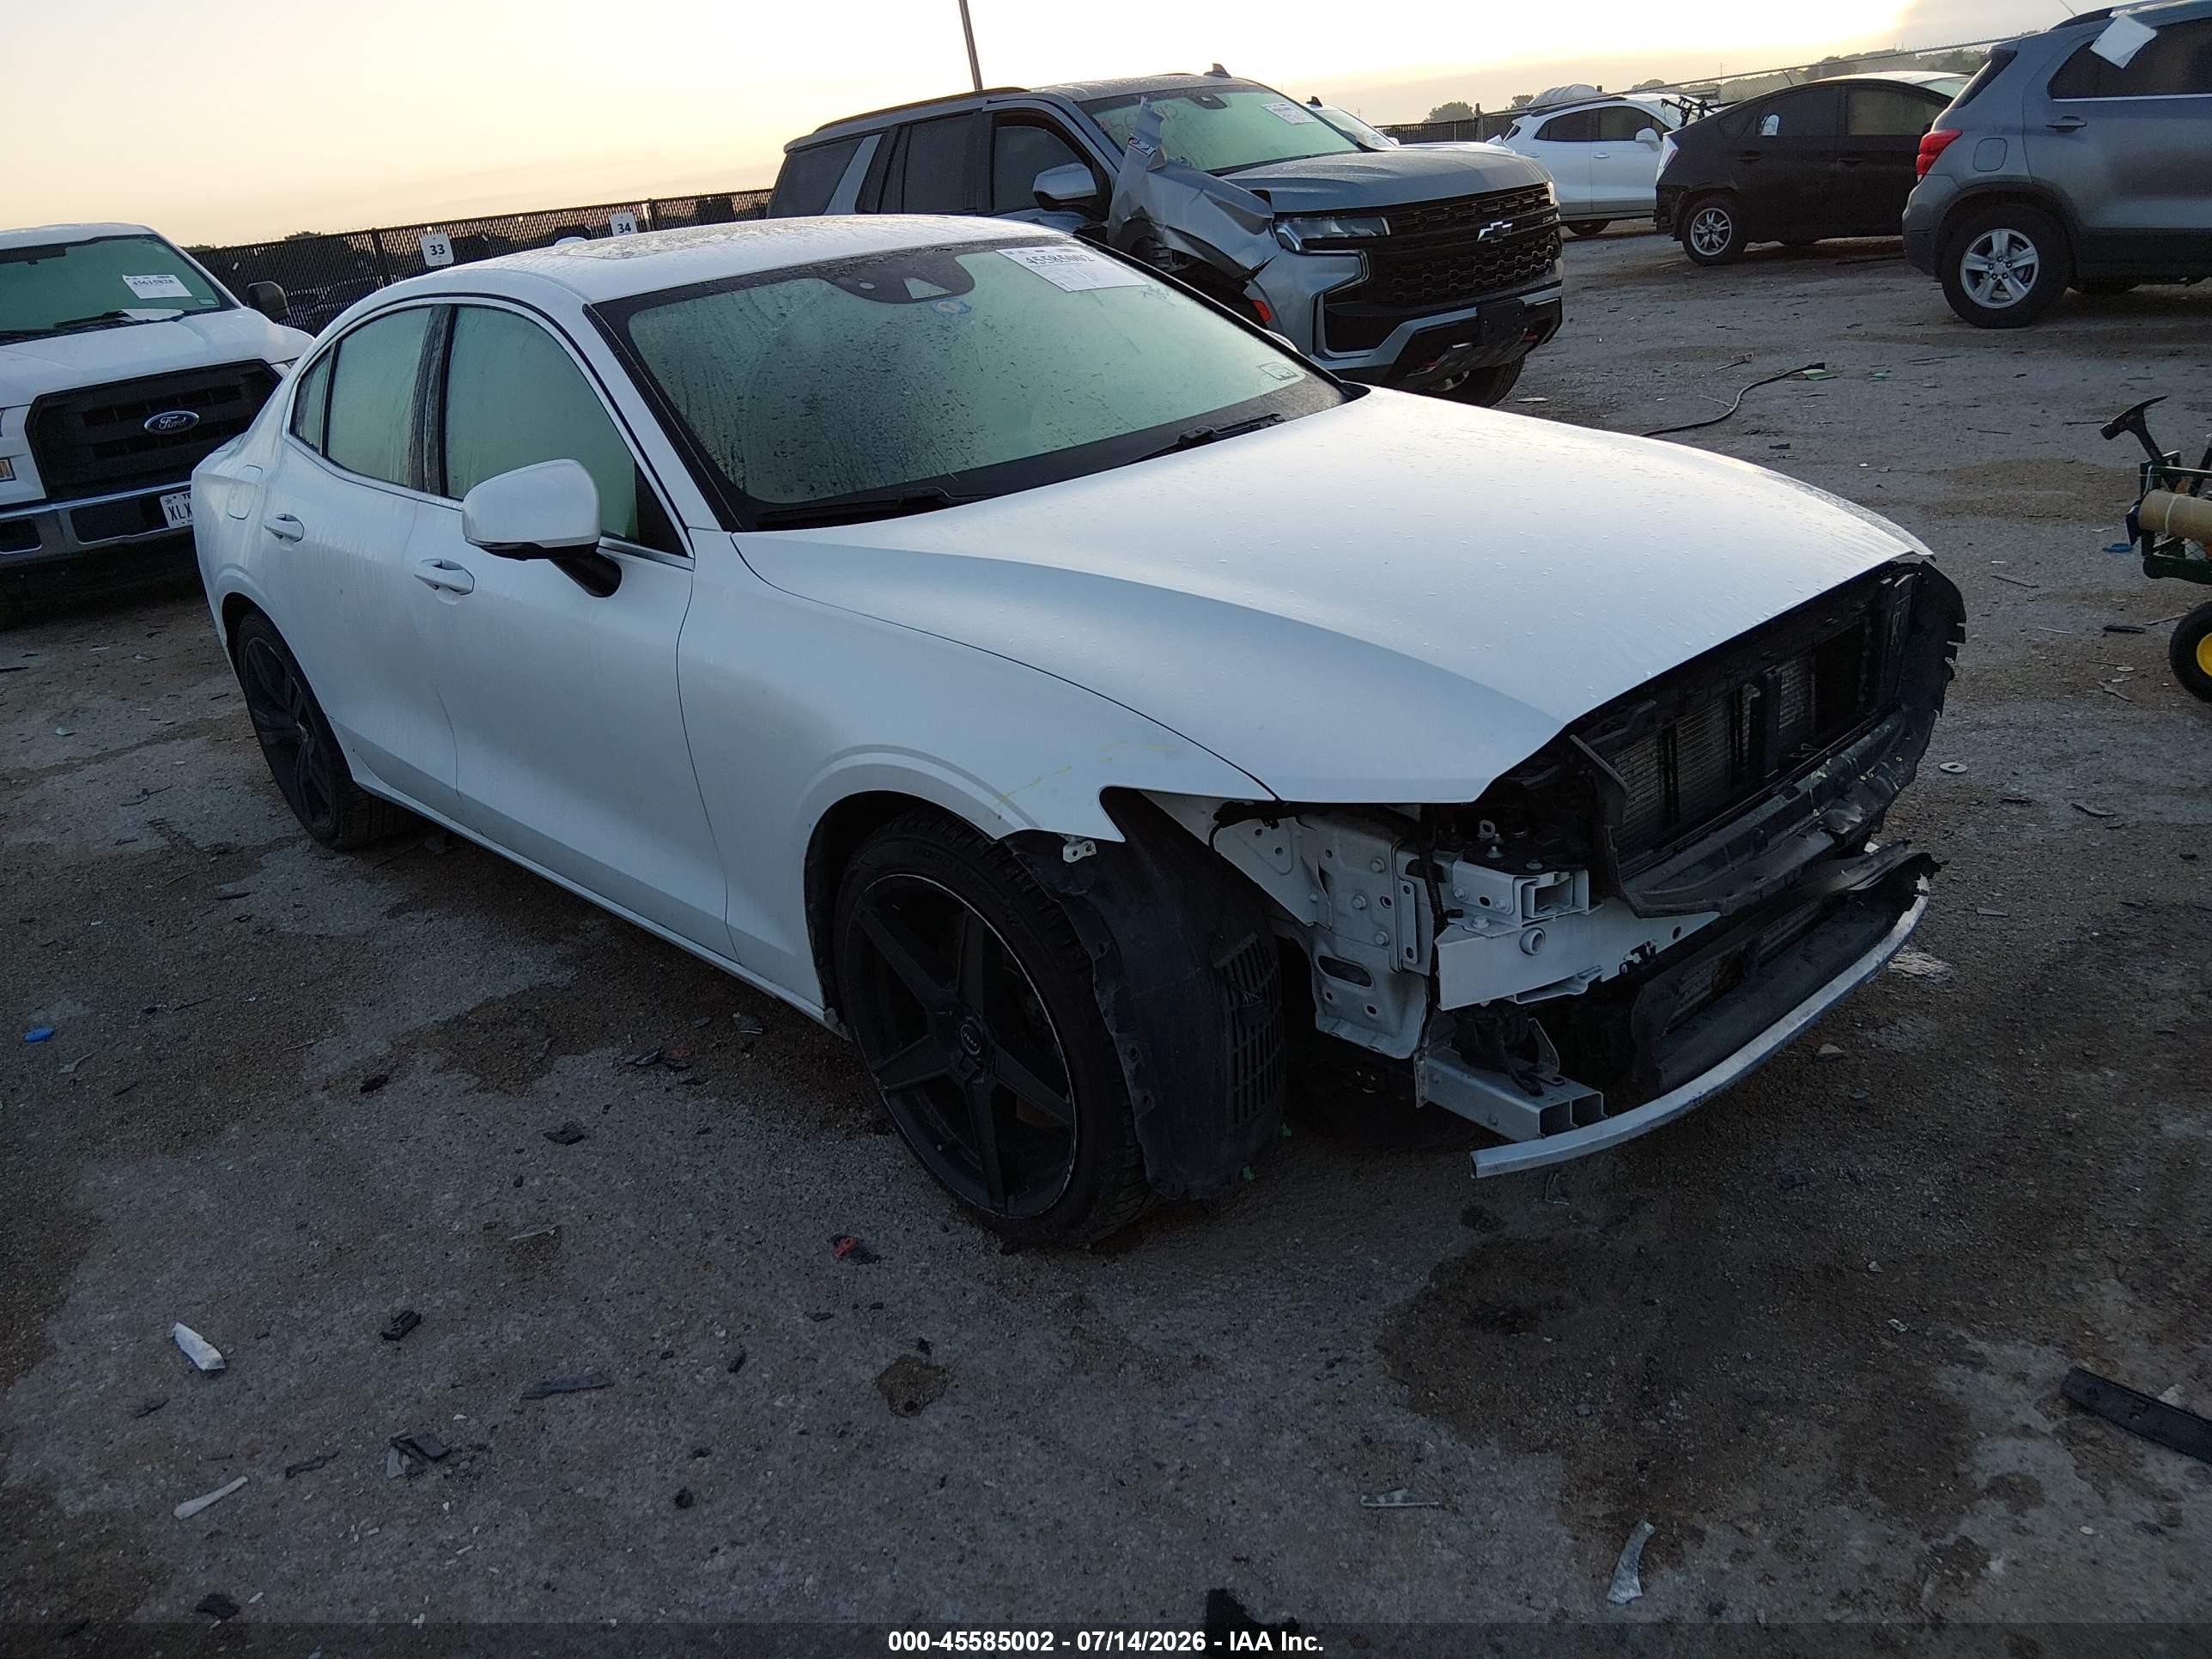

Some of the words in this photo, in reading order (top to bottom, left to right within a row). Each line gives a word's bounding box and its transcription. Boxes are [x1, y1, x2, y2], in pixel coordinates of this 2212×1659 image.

[617, 222, 632, 234] 34
[428, 244, 446, 256] 33
[158, 415, 186, 430] Ford
